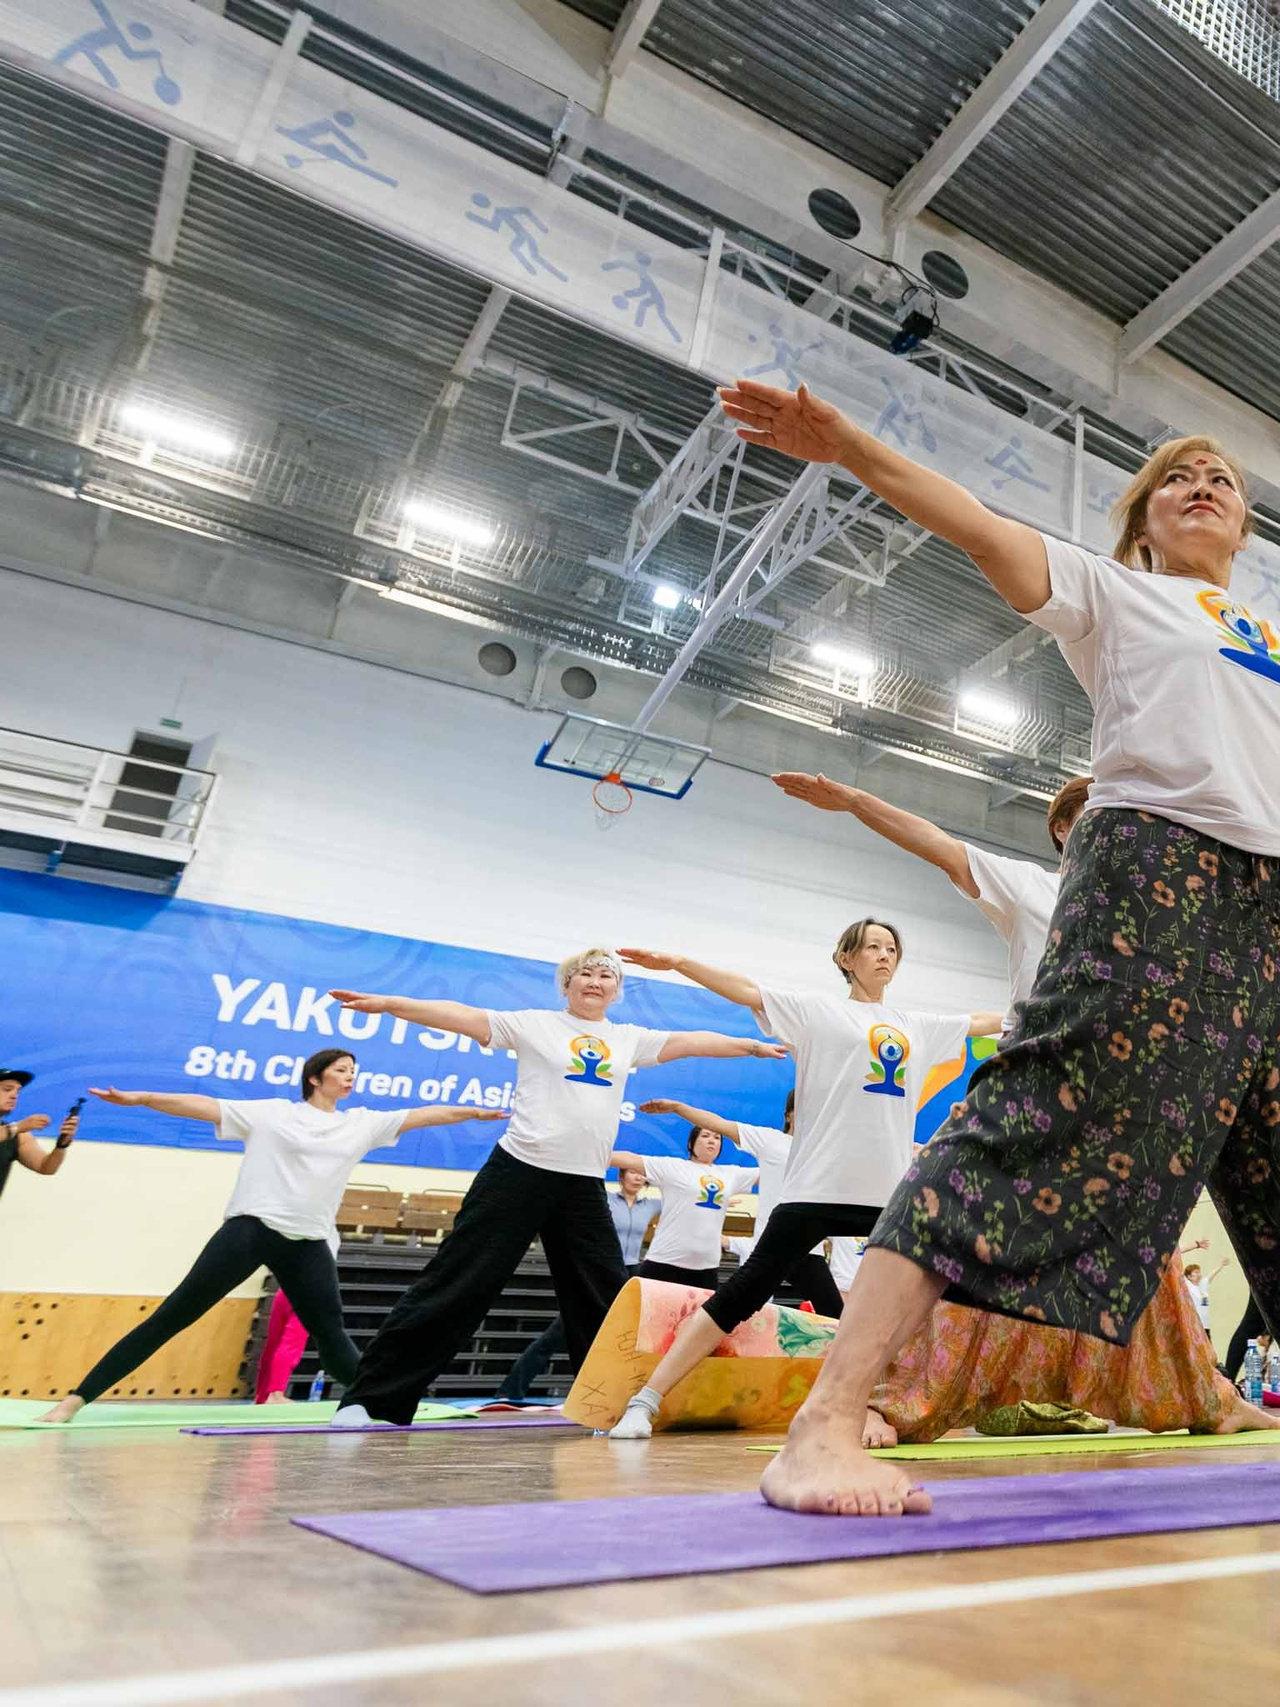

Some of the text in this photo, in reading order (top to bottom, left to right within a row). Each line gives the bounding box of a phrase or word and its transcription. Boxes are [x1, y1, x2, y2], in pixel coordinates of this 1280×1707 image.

[212, 973, 494, 1056] YAKUTS
[184, 1045, 517, 1109] 8th Cren of Asi
